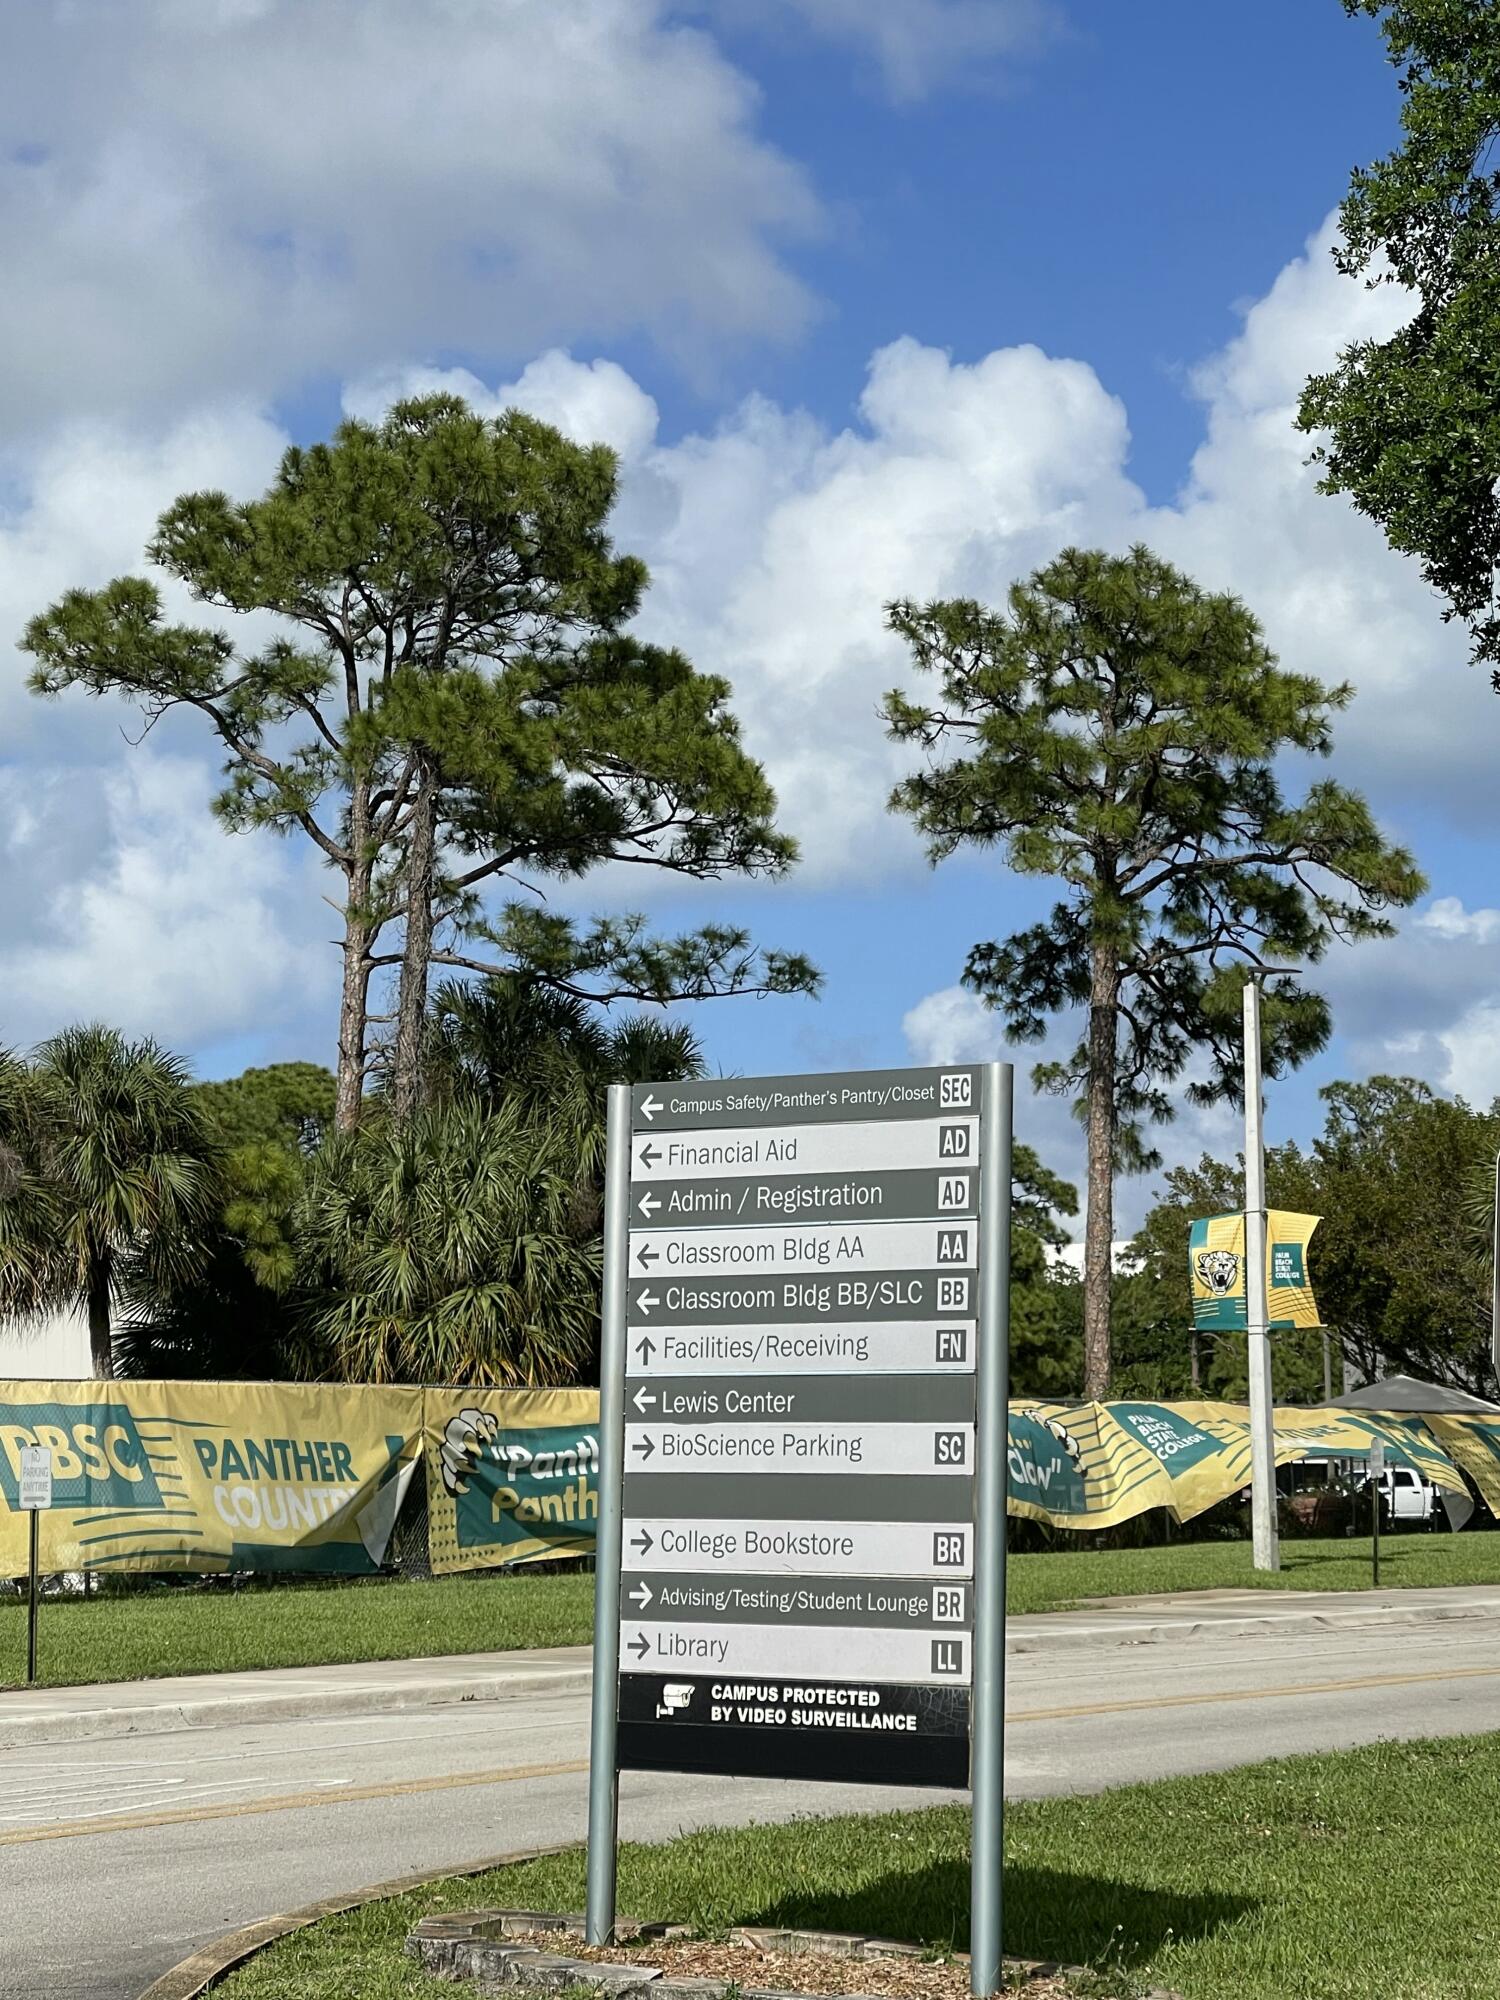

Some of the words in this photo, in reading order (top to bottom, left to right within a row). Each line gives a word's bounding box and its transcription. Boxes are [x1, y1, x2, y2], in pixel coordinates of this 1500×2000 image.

[670, 1098, 722, 1114] Campus
[841, 1086, 934, 1105] Pantry/Closet
[942, 1078, 970, 1102] SEC
[668, 1141, 758, 1166] Financial
[766, 1139, 797, 1161] Aid
[943, 1129, 967, 1154] AD
[668, 1189, 731, 1212] Admin
[737, 1187, 749, 1213] /
[757, 1183, 882, 1214] Registration
[943, 1180, 966, 1206] AD
[667, 1243, 774, 1264] Classroom
[783, 1238, 830, 1264] Bldg
[837, 1237, 864, 1259] AA
[939, 1234, 964, 1259] AA
[667, 1287, 774, 1309] Classroom
[783, 1285, 830, 1311] Bldg
[838, 1281, 922, 1309] BB/SLC
[941, 1281, 964, 1307] BB
[664, 1335, 869, 1362] Facilities/Receiving
[940, 1333, 962, 1358] FN
[663, 1391, 719, 1413] Lewis
[725, 1390, 795, 1412] Center
[662, 1434, 774, 1456] BioScience
[783, 1433, 862, 1462] Parking
[939, 1436, 962, 1461] SC
[1146, 1430, 1180, 1448] STATE
[1156, 1433, 1207, 1460] COLLEGE
[23, 1466, 48, 1478] PARKING
[193, 1438, 360, 1482] PANTHER
[23, 1481, 48, 1492] ANYTIME
[660, 1530, 737, 1558] College
[745, 1532, 853, 1556] Bookstore
[937, 1537, 961, 1562] BR
[660, 1588, 862, 1612] Advising/Testing/Student
[868, 1594, 928, 1616] Lounge
[936, 1592, 960, 1617] BR
[658, 1634, 728, 1662] Library
[937, 1645, 957, 1670] LL
[712, 1685, 778, 1702] CAMPUS
[783, 1687, 880, 1707] PROTECTED
[711, 1707, 732, 1722] BY
[738, 1708, 786, 1725] VIDEO
[791, 1711, 917, 1731] SURVEILLANCE
